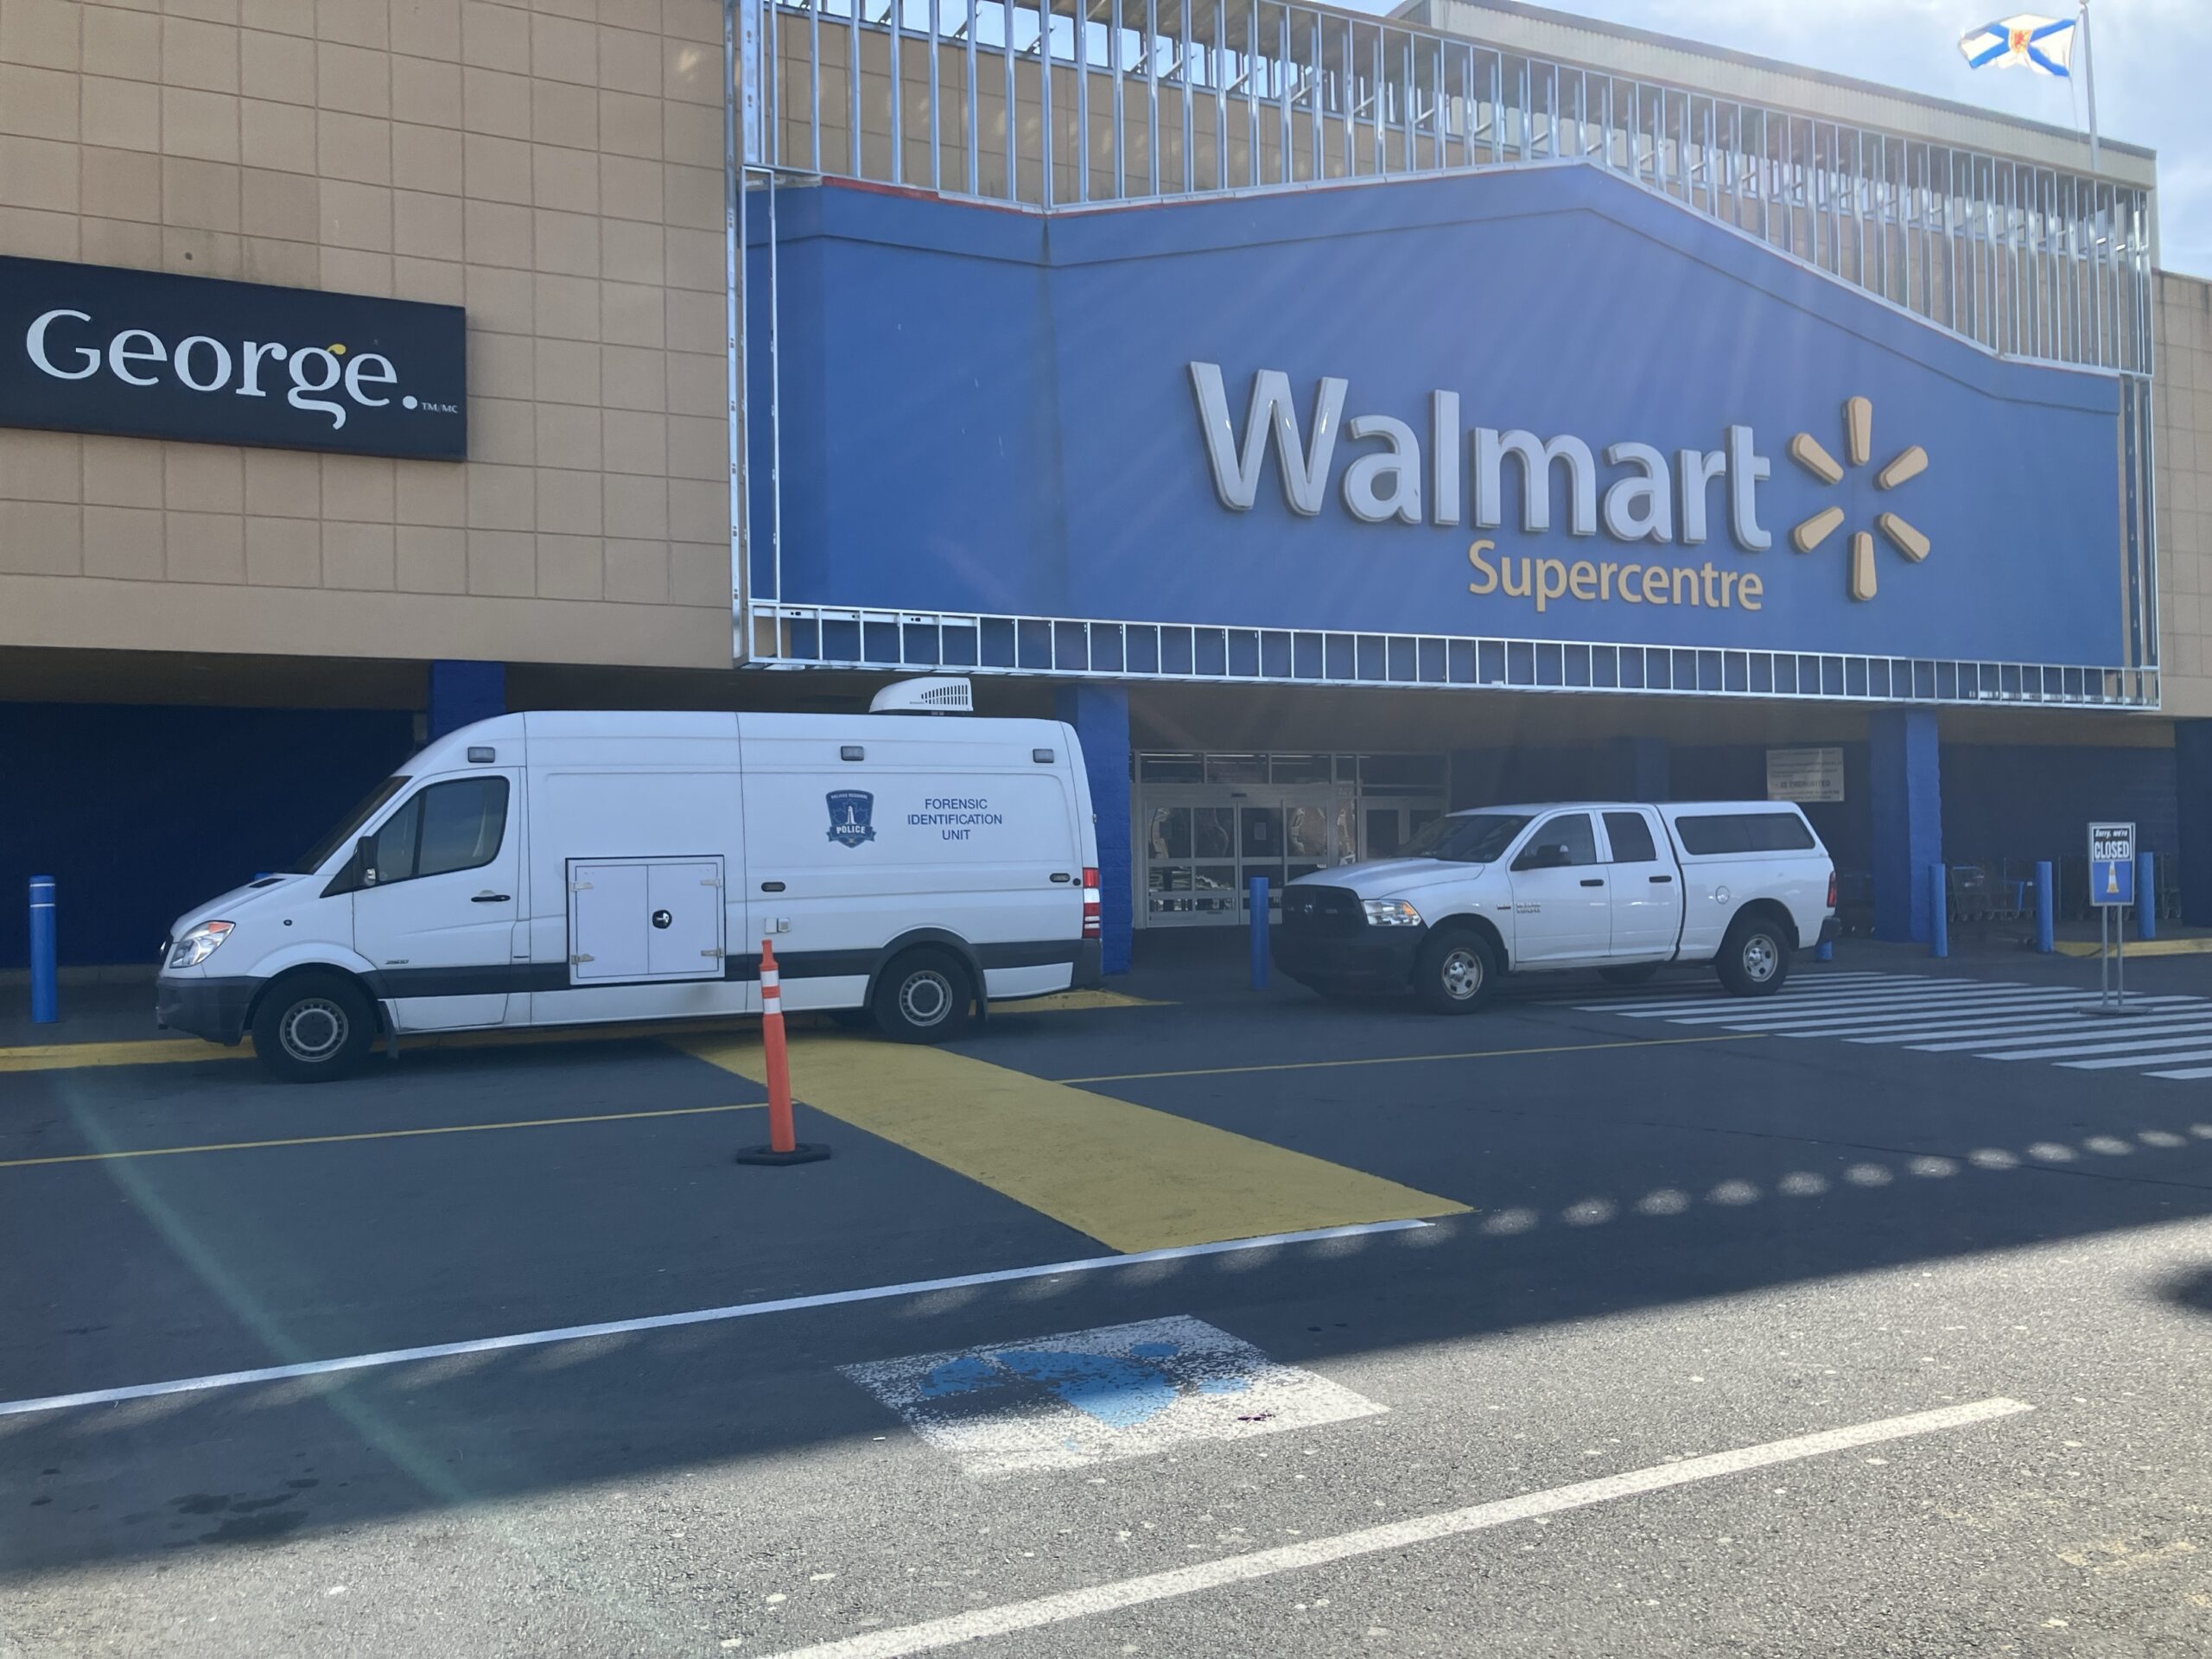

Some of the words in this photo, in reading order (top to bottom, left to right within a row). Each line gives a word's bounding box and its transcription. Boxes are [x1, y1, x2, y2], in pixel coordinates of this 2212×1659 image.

[1190, 360, 1772, 551] Walmart
[1468, 539, 1764, 612] Supercentre
[925, 798, 988, 810] FORENSIC
[907, 814, 1002, 825] IDENTIFICATION
[836, 825, 866, 835] POLICE
[942, 830, 970, 841] UNIT
[2094, 841, 2130, 859] CLOSED
